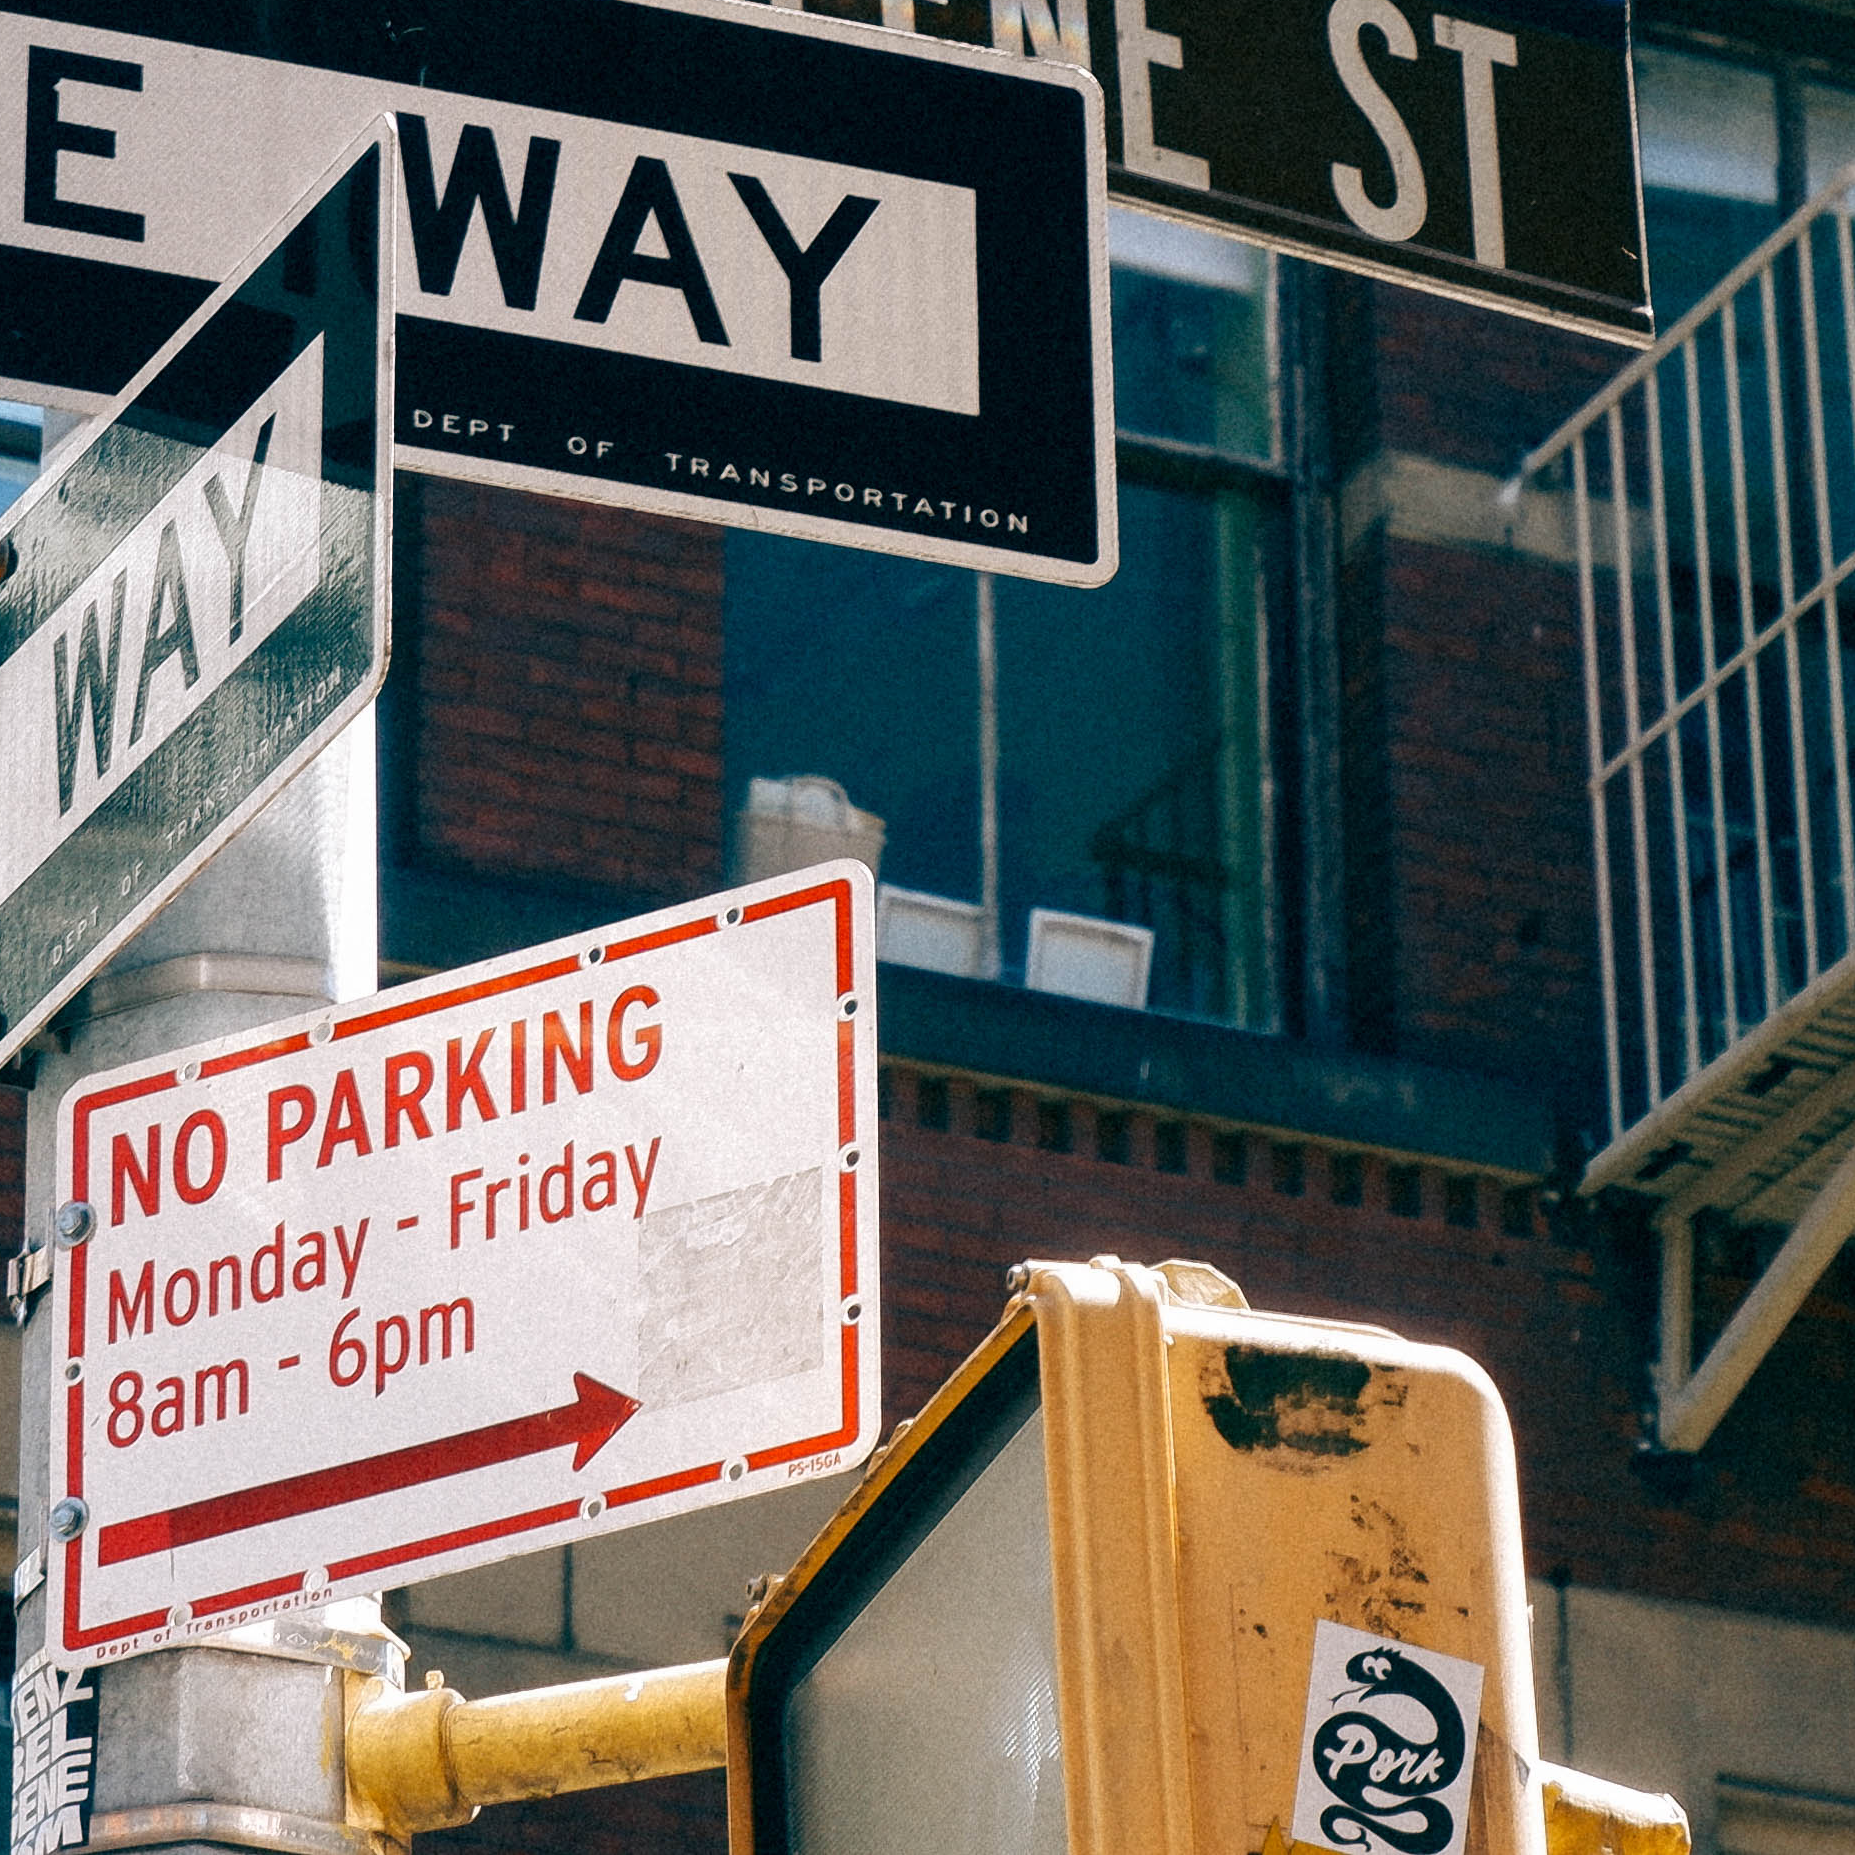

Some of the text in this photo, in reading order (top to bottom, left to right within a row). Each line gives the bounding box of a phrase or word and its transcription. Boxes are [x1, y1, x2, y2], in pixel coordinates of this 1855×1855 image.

[395, 111, 881, 362] WAY
[412, 409, 1029, 534] DEPT OF TRANSPORTATION
[52, 411, 276, 818] WAY
[51, 665, 342, 965] DEPT OF TRANSPORTATION
[110, 985, 664, 1227] NO PARKING
[107, 1216, 370, 1345] Monday
[449, 1136, 663, 1252] Friday
[106, 1360, 250, 1449] 8am
[328, 1297, 475, 1399] 6pm
[96, 1587, 333, 1659] Dept of Transportation
[1323, 1723, 1445, 1785] Pork
